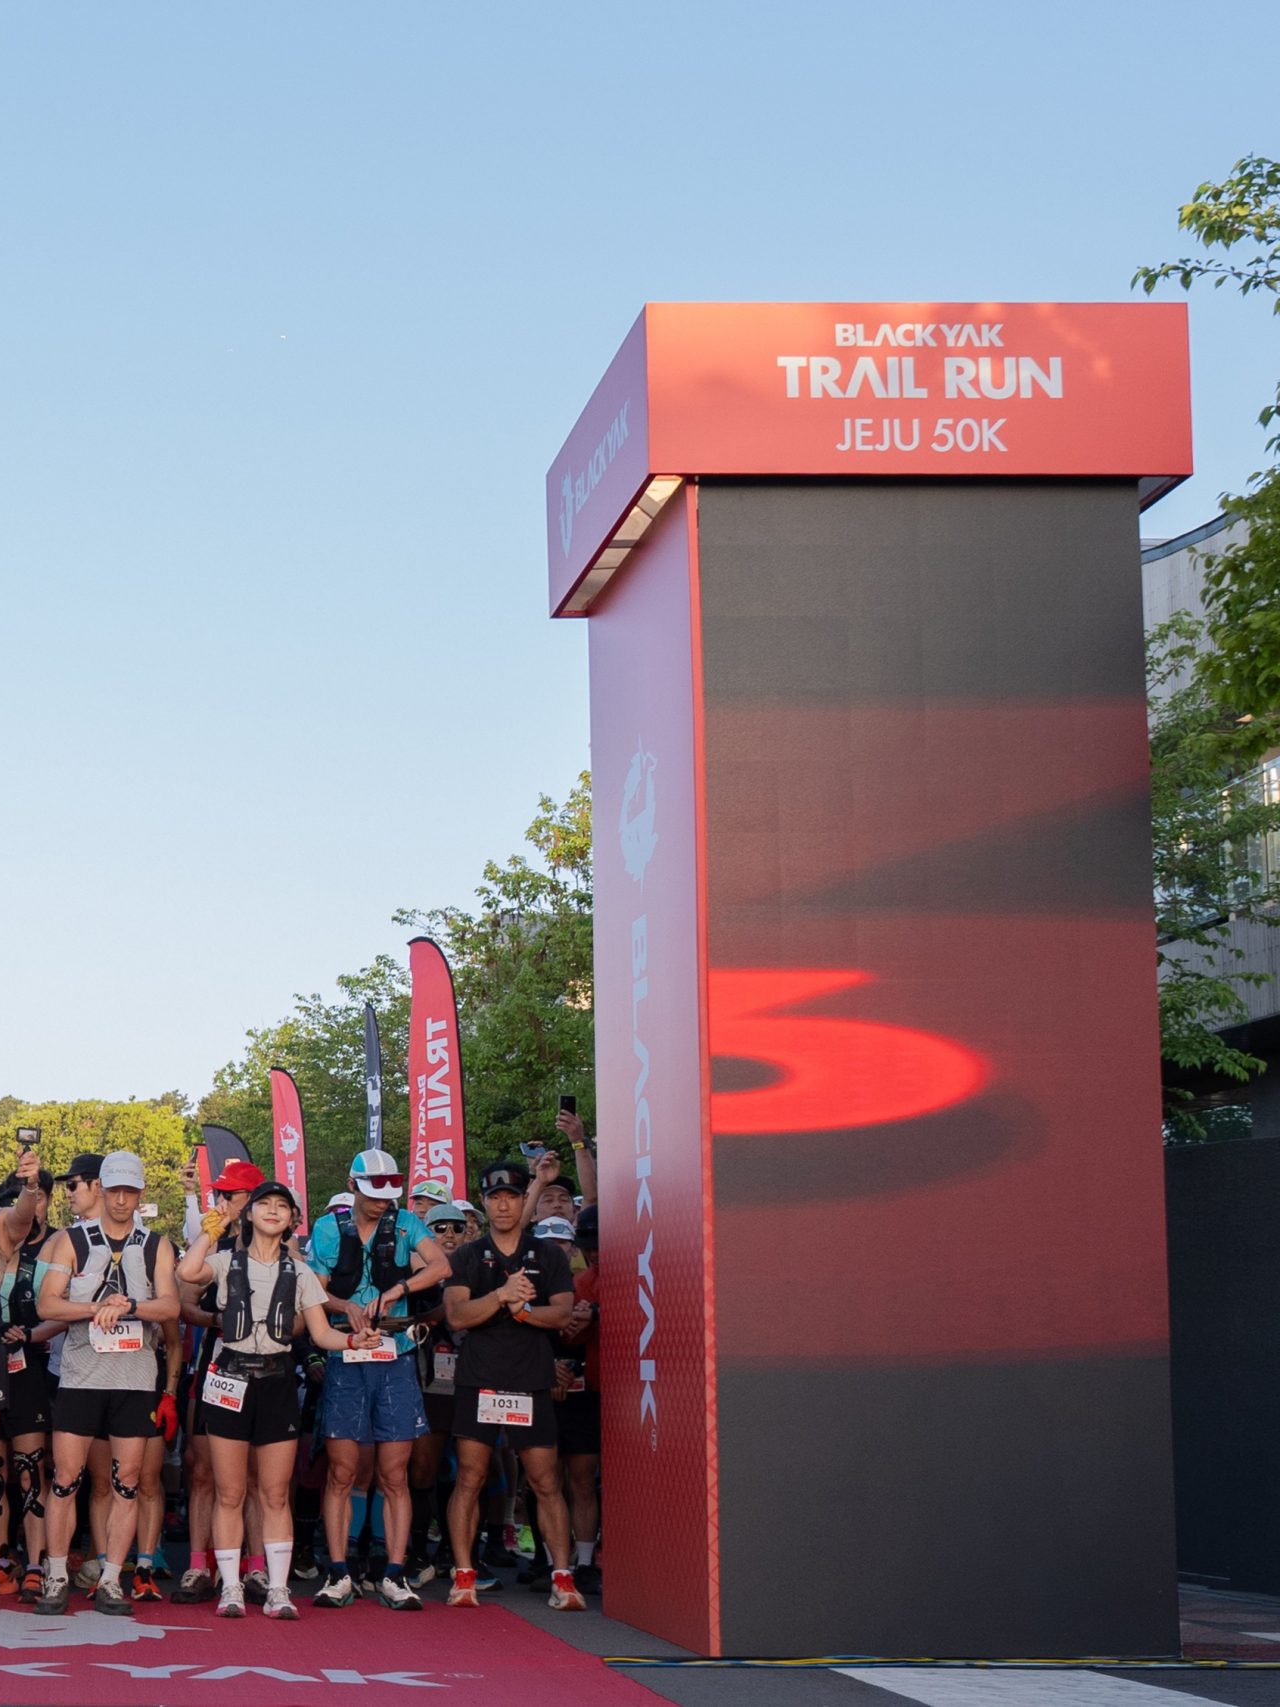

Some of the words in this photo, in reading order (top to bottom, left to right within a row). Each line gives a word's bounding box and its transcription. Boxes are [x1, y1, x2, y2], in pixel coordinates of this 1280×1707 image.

[777, 356, 928, 399] TRAIL
[945, 356, 1062, 399] RUN
[836, 418, 920, 451] JEJU
[931, 418, 1008, 452] 50K
[209, 1377, 236, 1394] 1002
[491, 1397, 520, 1410] 1031
